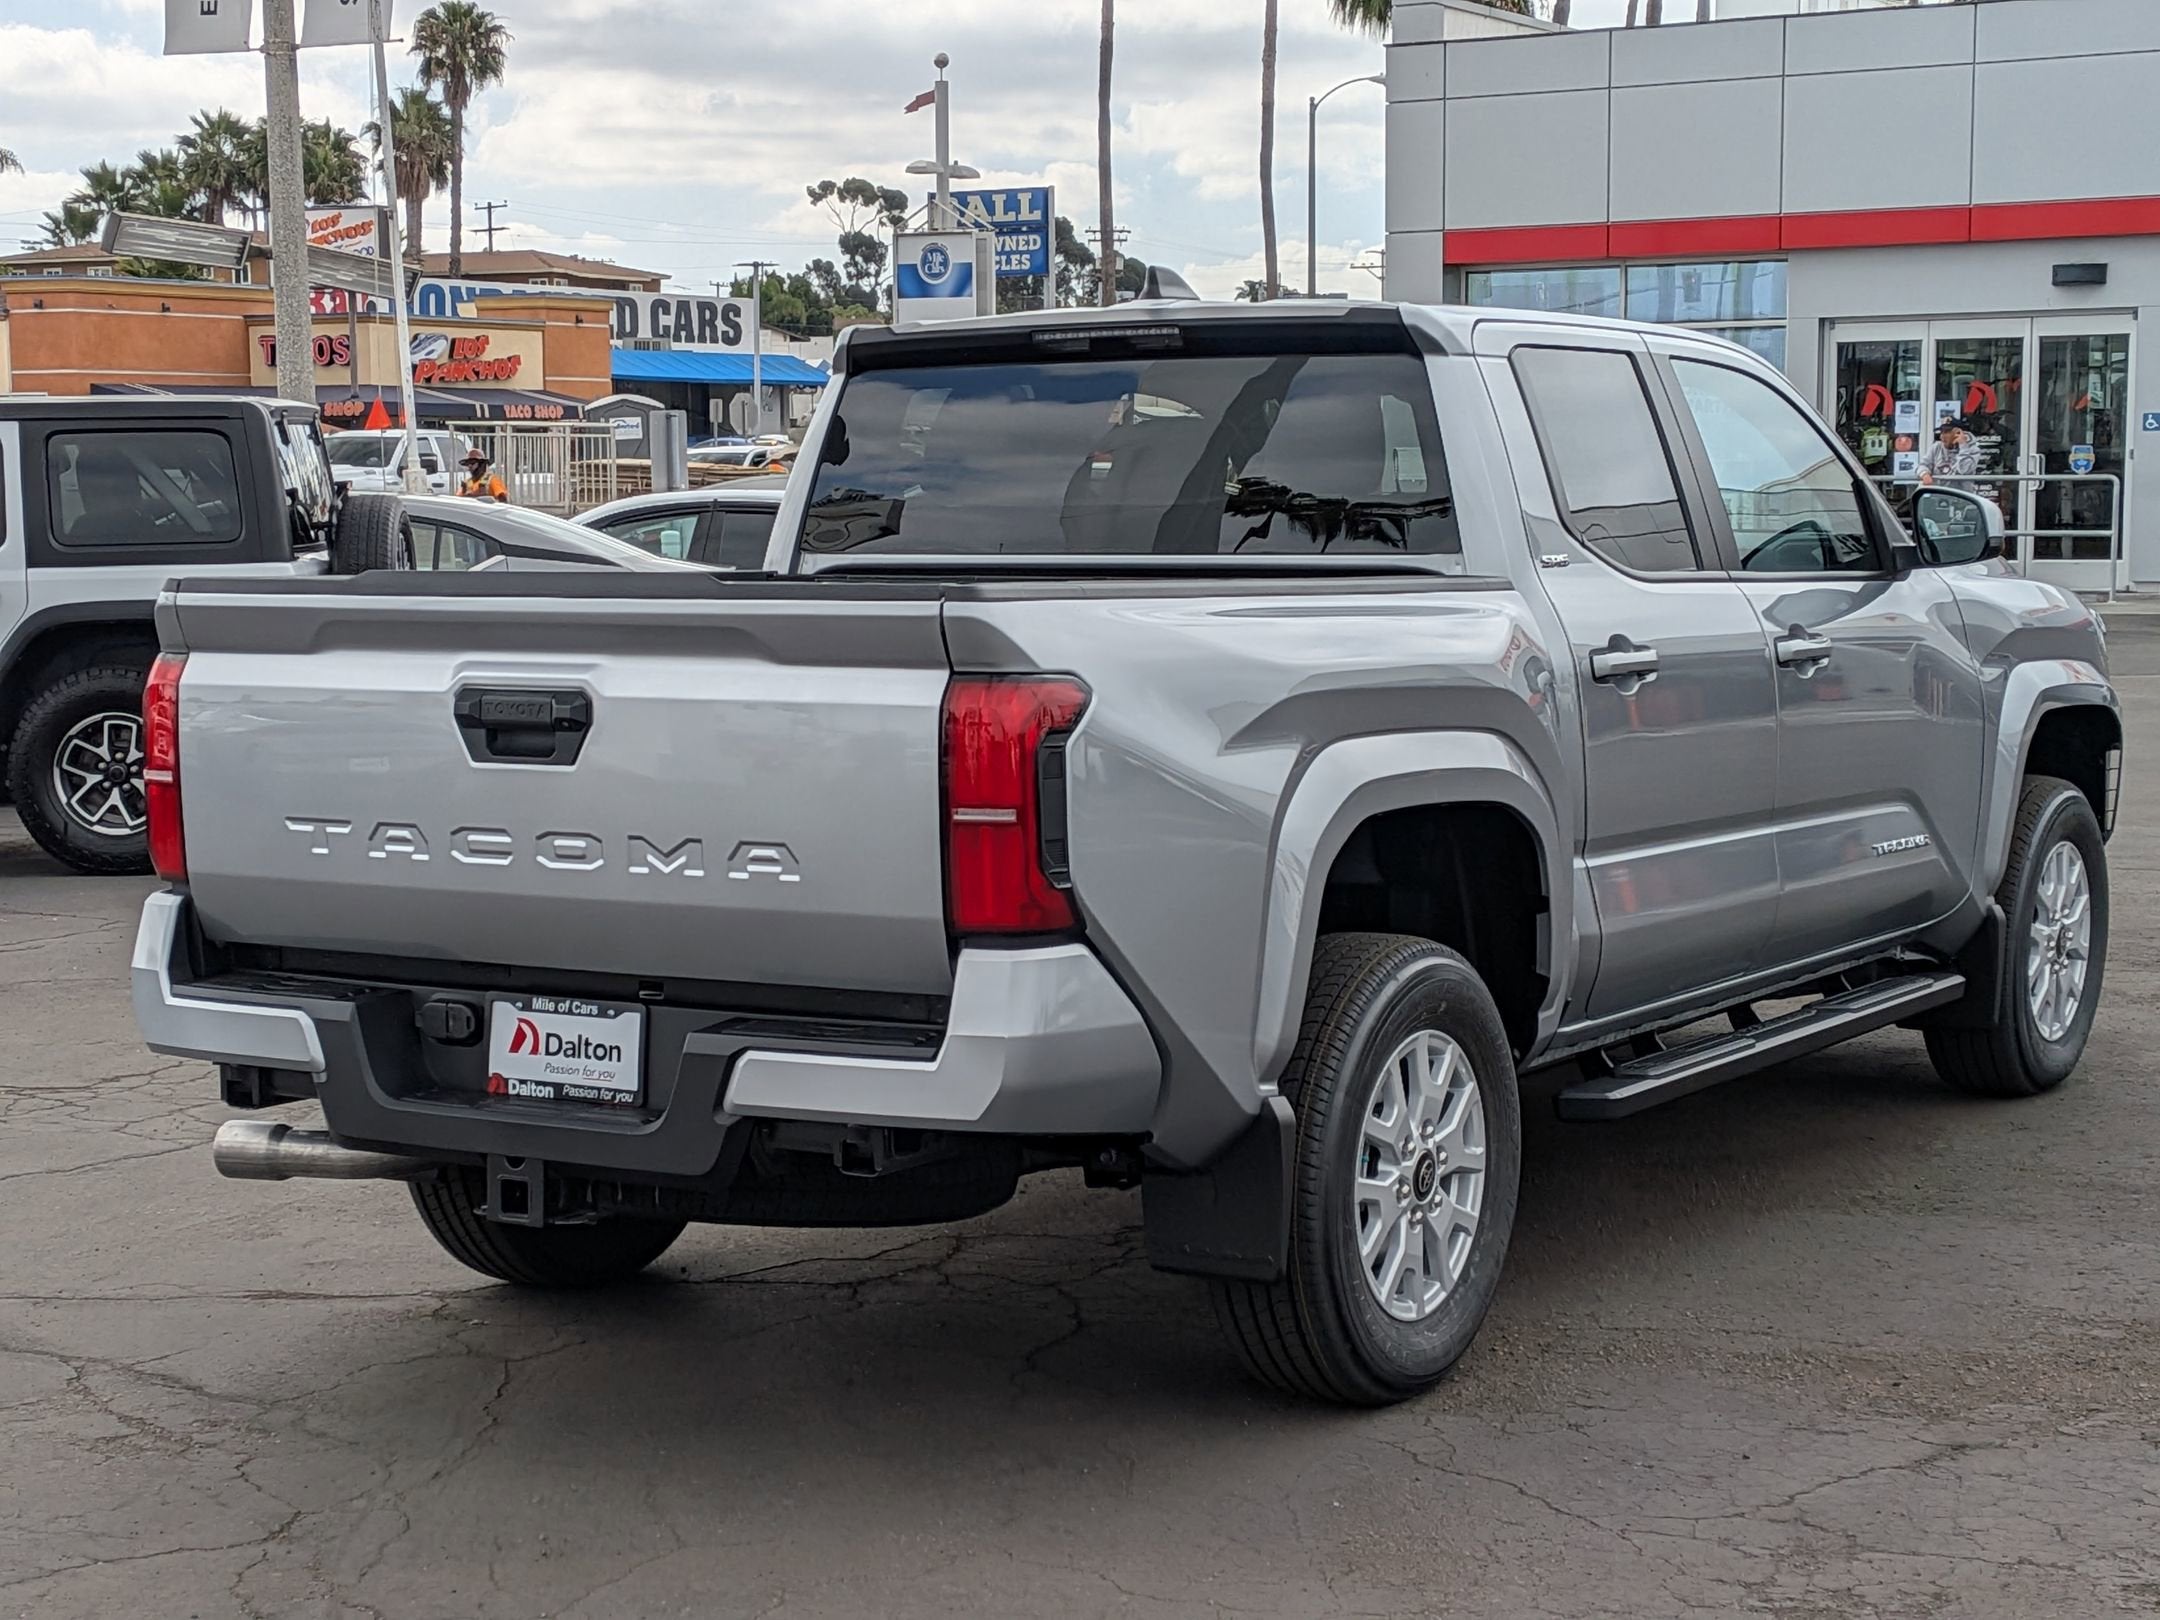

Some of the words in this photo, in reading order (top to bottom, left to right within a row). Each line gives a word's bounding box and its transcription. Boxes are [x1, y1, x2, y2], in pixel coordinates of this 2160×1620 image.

[994, 234, 1041, 251] WNED
[650, 298, 743, 346] CARS
[258, 335, 350, 366] TOS
[450, 335, 490, 359] LOS
[413, 355, 521, 384] PANCHOS
[324, 400, 365, 417] SHOP
[503, 404, 533, 418] TACO
[534, 405, 564, 418] SHOP
[484, 702, 545, 718] TOYOTA
[284, 816, 801, 882] TACOMA
[1872, 834, 1931, 857] TACOMA
[532, 997, 555, 1012] Mile
[558, 1000, 570, 1012] of
[571, 1001, 599, 1016] Cars
[544, 1032, 622, 1063] Dalton
[544, 1063, 580, 1076] Passion
[582, 1065, 597, 1078] for
[598, 1069, 616, 1080] you
[508, 1079, 555, 1098] Dalton
[562, 1084, 599, 1099] Passion
[599, 1088, 614, 1100] for
[614, 1091, 634, 1104] you
